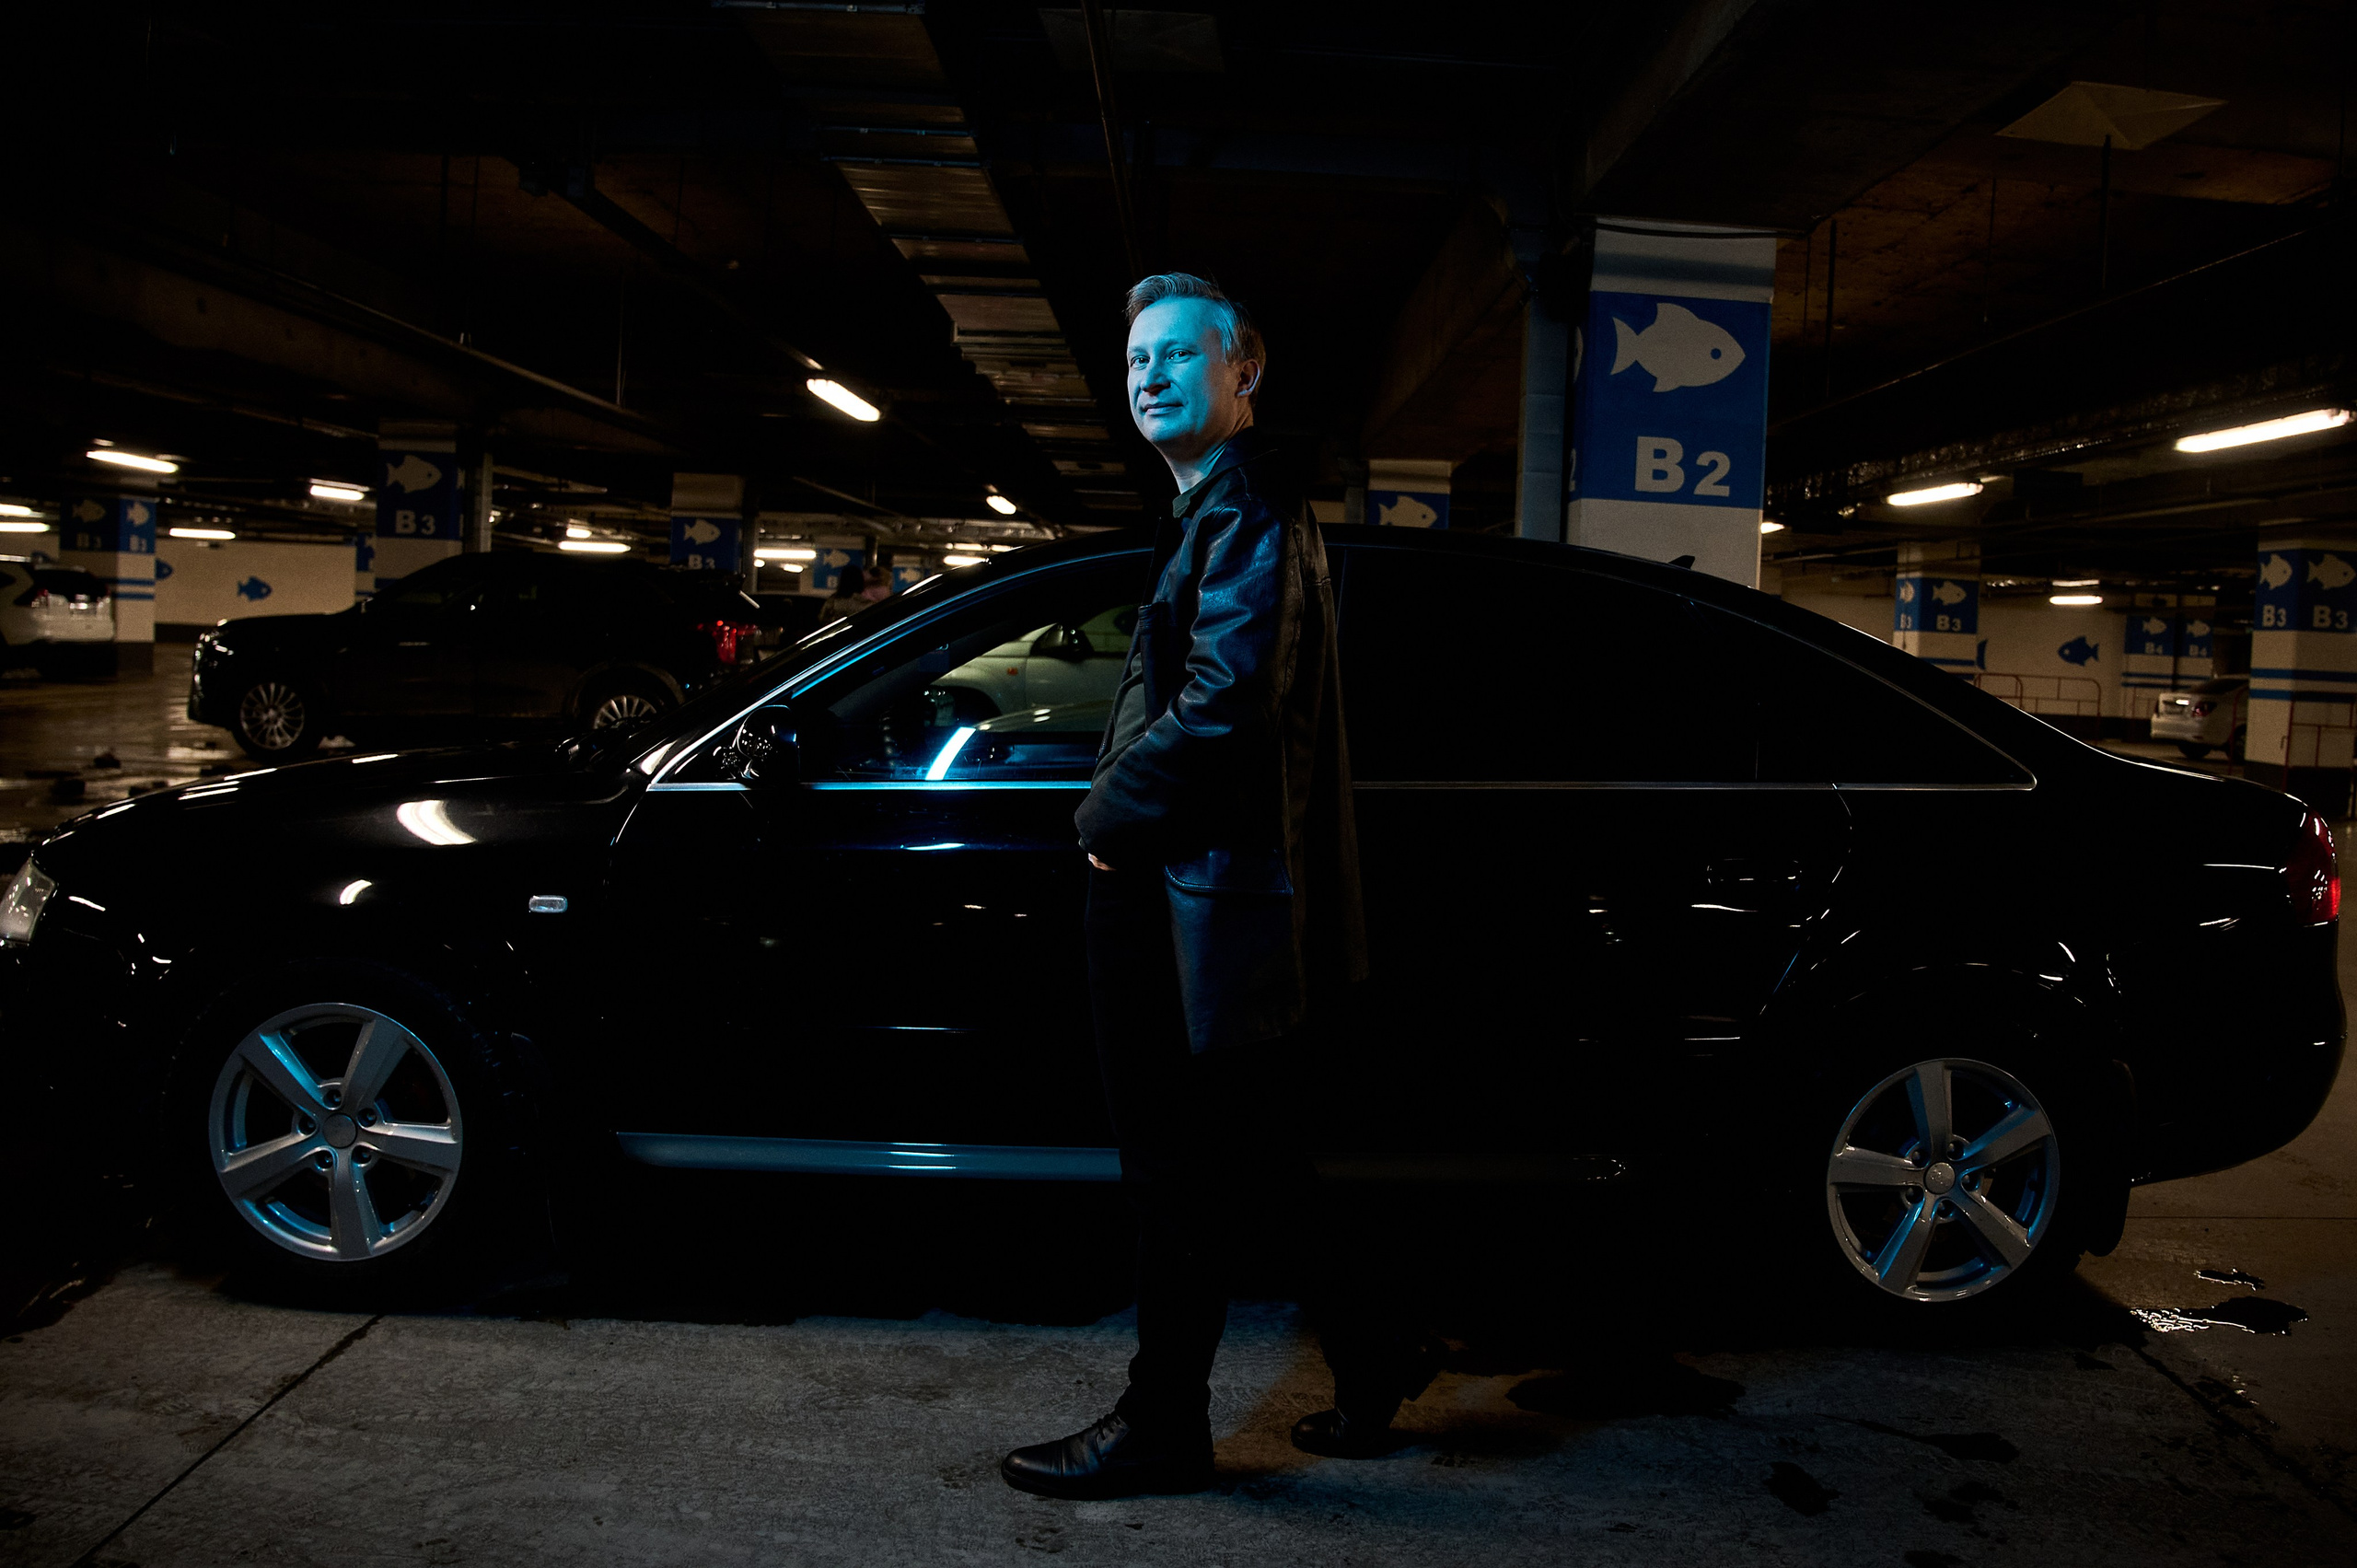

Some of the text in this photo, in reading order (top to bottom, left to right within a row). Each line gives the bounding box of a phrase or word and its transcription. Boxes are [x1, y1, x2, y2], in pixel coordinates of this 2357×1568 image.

[1634, 436, 1731, 497] B2
[395, 509, 435, 535] B3
[1935, 613, 1963, 633] B3
[2261, 604, 2287, 628] B3
[2312, 604, 2349, 630] B3
